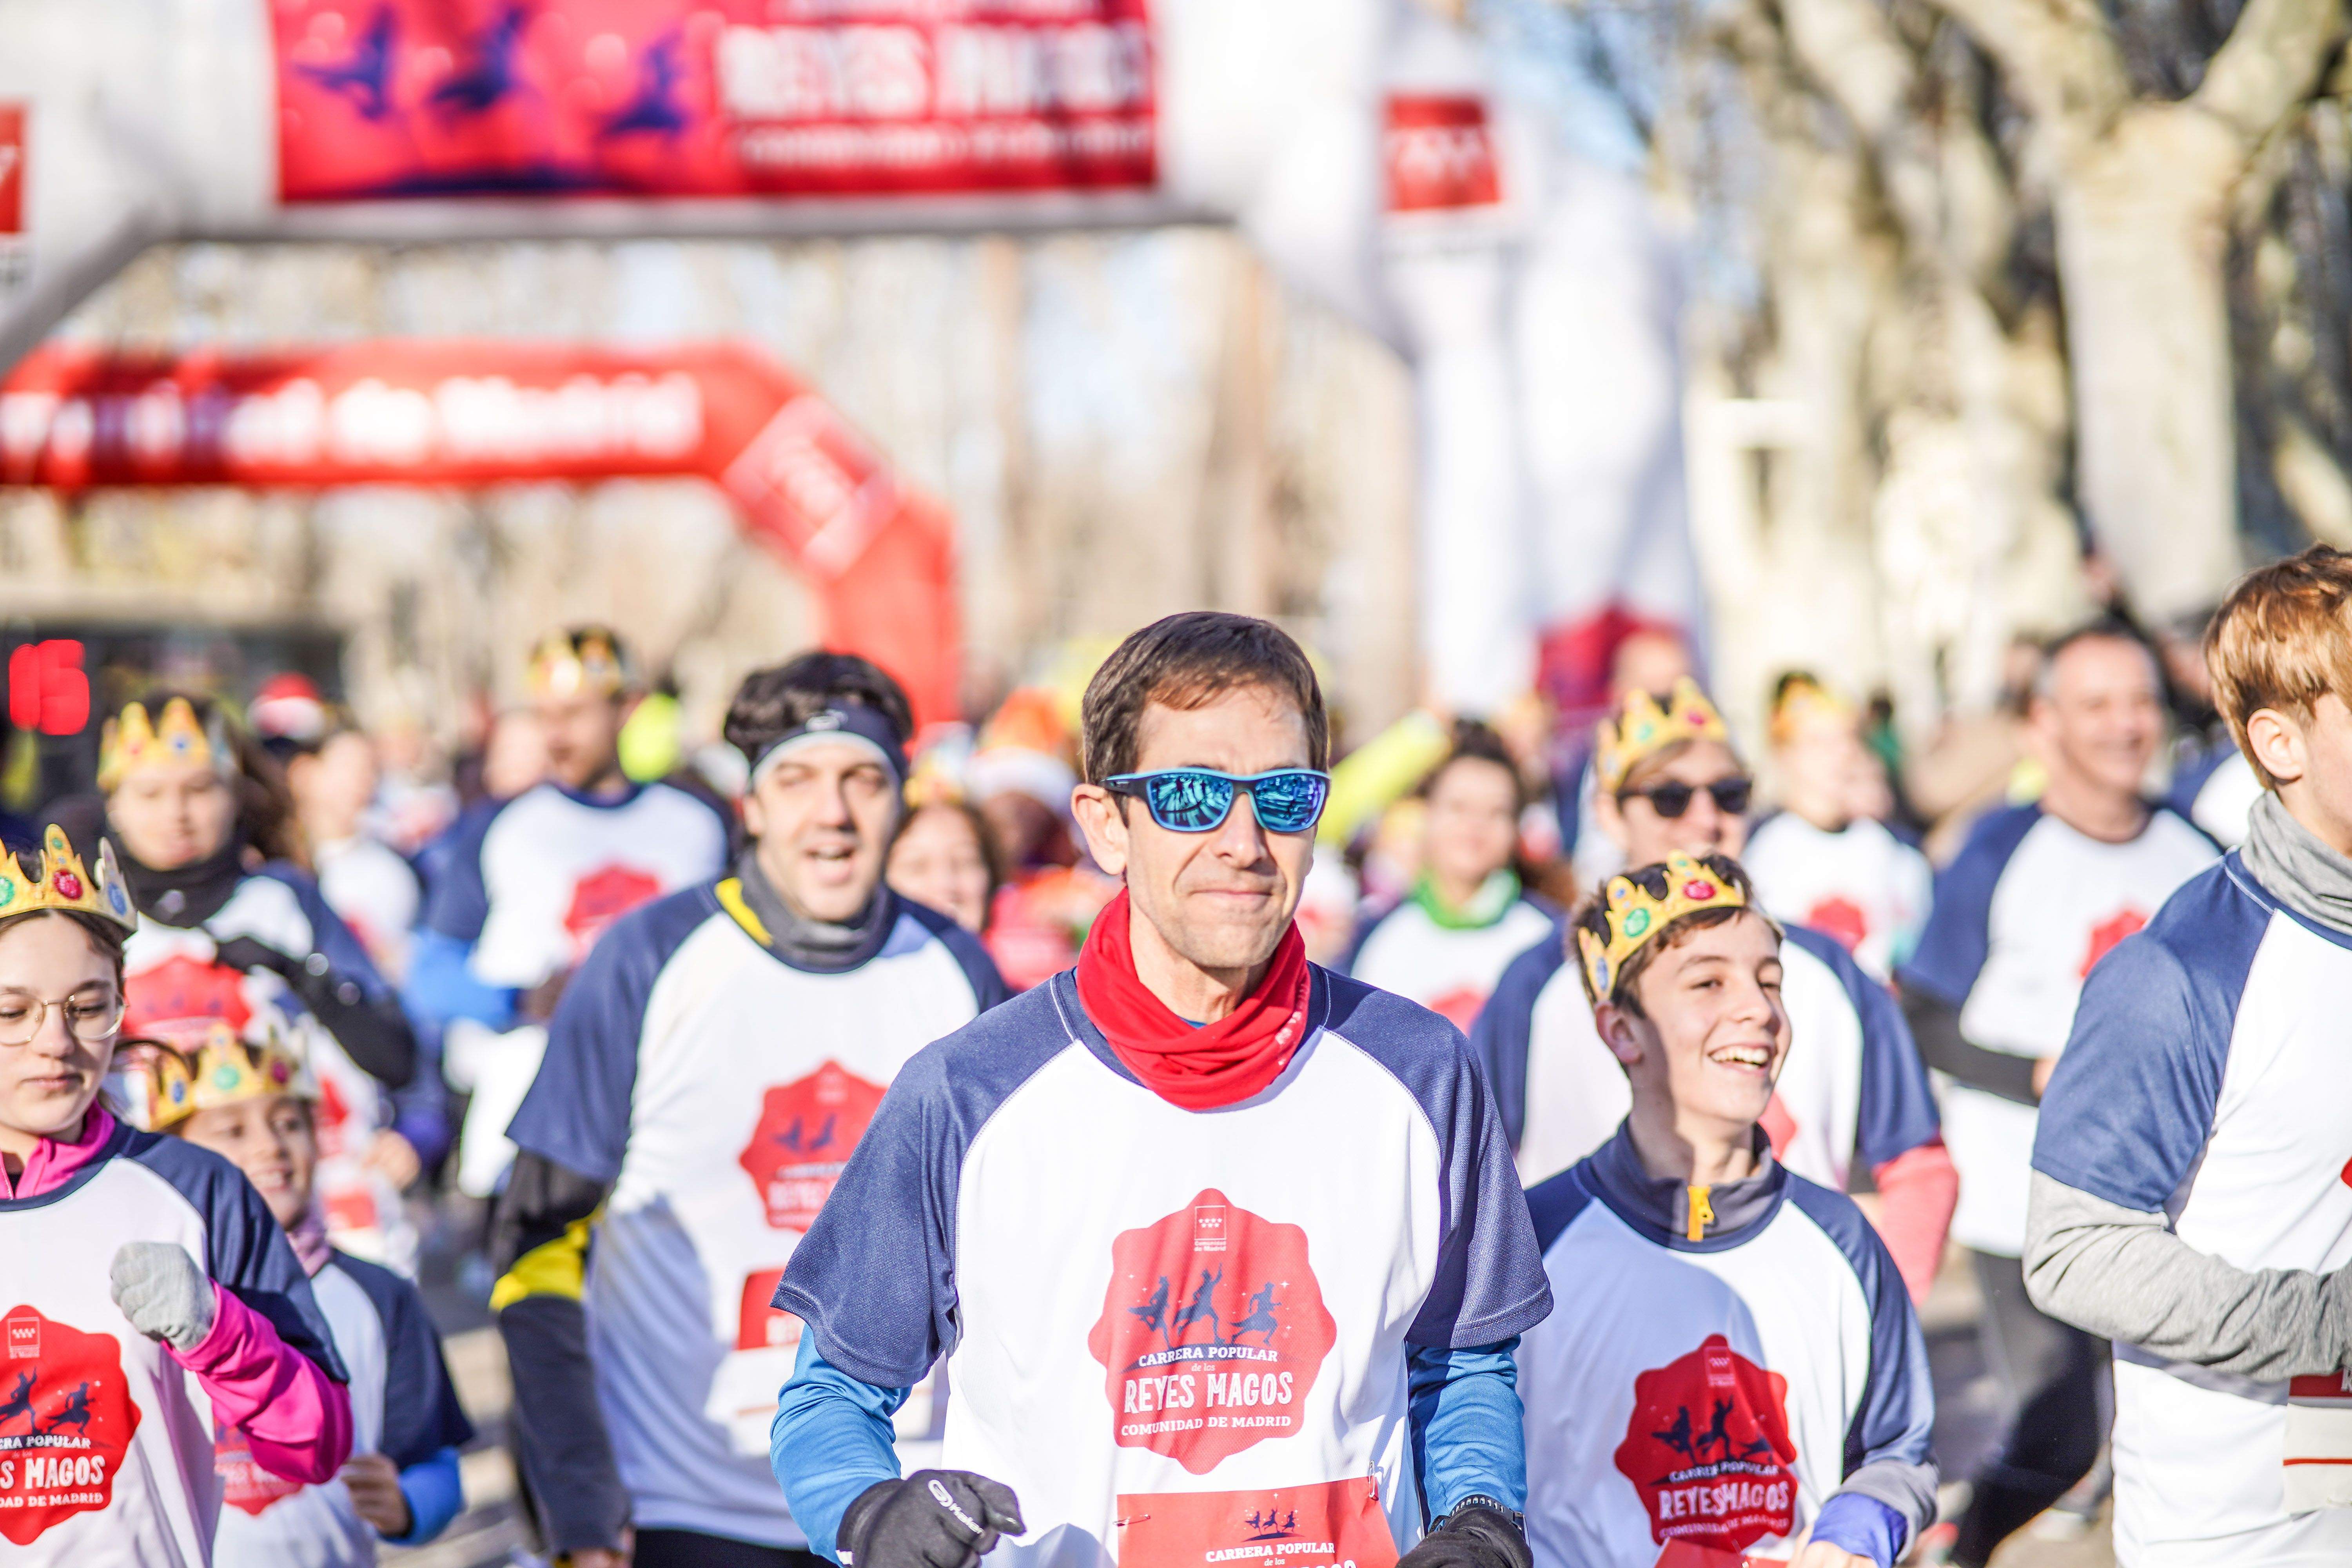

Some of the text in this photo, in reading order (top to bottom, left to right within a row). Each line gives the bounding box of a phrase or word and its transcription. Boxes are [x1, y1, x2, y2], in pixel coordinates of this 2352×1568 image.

[1139, 1347, 1278, 1367] CARRERA POPULAR
[1191, 1363, 1215, 1372] de los
[1124, 1372, 1293, 1414] REYES MAGOS
[1121, 1416, 1291, 1436] COMUNIDAD DE MADRID
[26, 1435, 91, 1449] POPULAR
[25, 1455, 105, 1489] MAGOS
[28, 1495, 47, 1507] DE
[49, 1492, 103, 1506] MADRID
[1658, 1481, 1790, 1521] REYES MAGOS
[1205, 1542, 1335, 1562] CARRERA POPULAR
[1264, 1558, 1273, 1566] de
